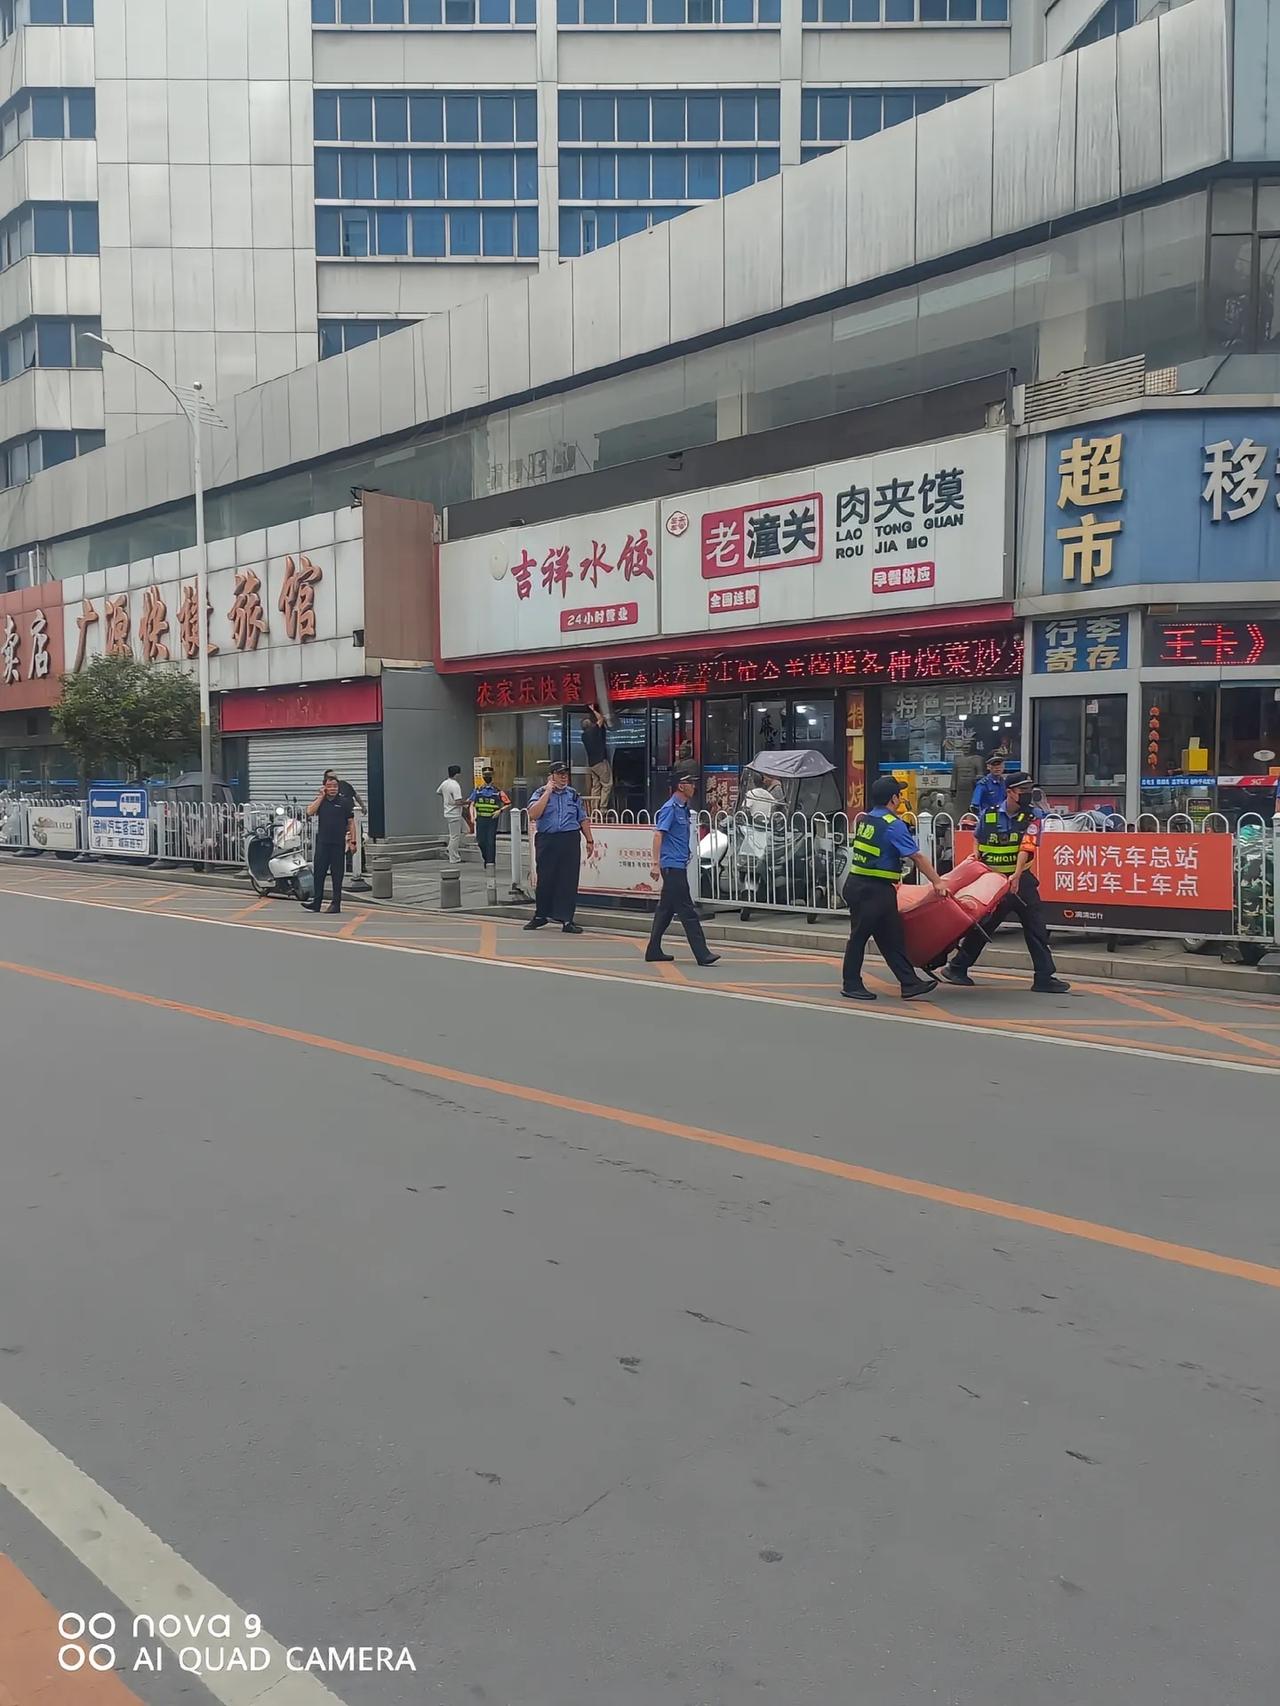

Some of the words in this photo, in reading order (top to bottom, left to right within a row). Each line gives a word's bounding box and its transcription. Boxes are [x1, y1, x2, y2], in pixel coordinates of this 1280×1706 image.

[1201, 438, 1280, 521] 移
[835, 467, 965, 527] 肉夹馍
[1056, 433, 1125, 584] 超市
[705, 506, 817, 568] 老潼关
[836, 528, 863, 542] LAO
[875, 520, 913, 536] TONG
[924, 513, 964, 530] GUAN
[836, 544, 864, 559] ROU
[875, 540, 898, 555] JIA
[906, 535, 929, 549] MO
[511, 529, 654, 600] 吉祥水饺
[710, 589, 756, 608] 全国连锁
[567, 607, 629, 627] 24小时营业
[1045, 617, 1121, 645] 行李
[1045, 646, 1120, 672] 寄存
[477, 672, 582, 708] 农家乐快餐
[1053, 844, 1199, 869] 徐州汽车总站
[1055, 871, 1199, 897] 网约车上车点
